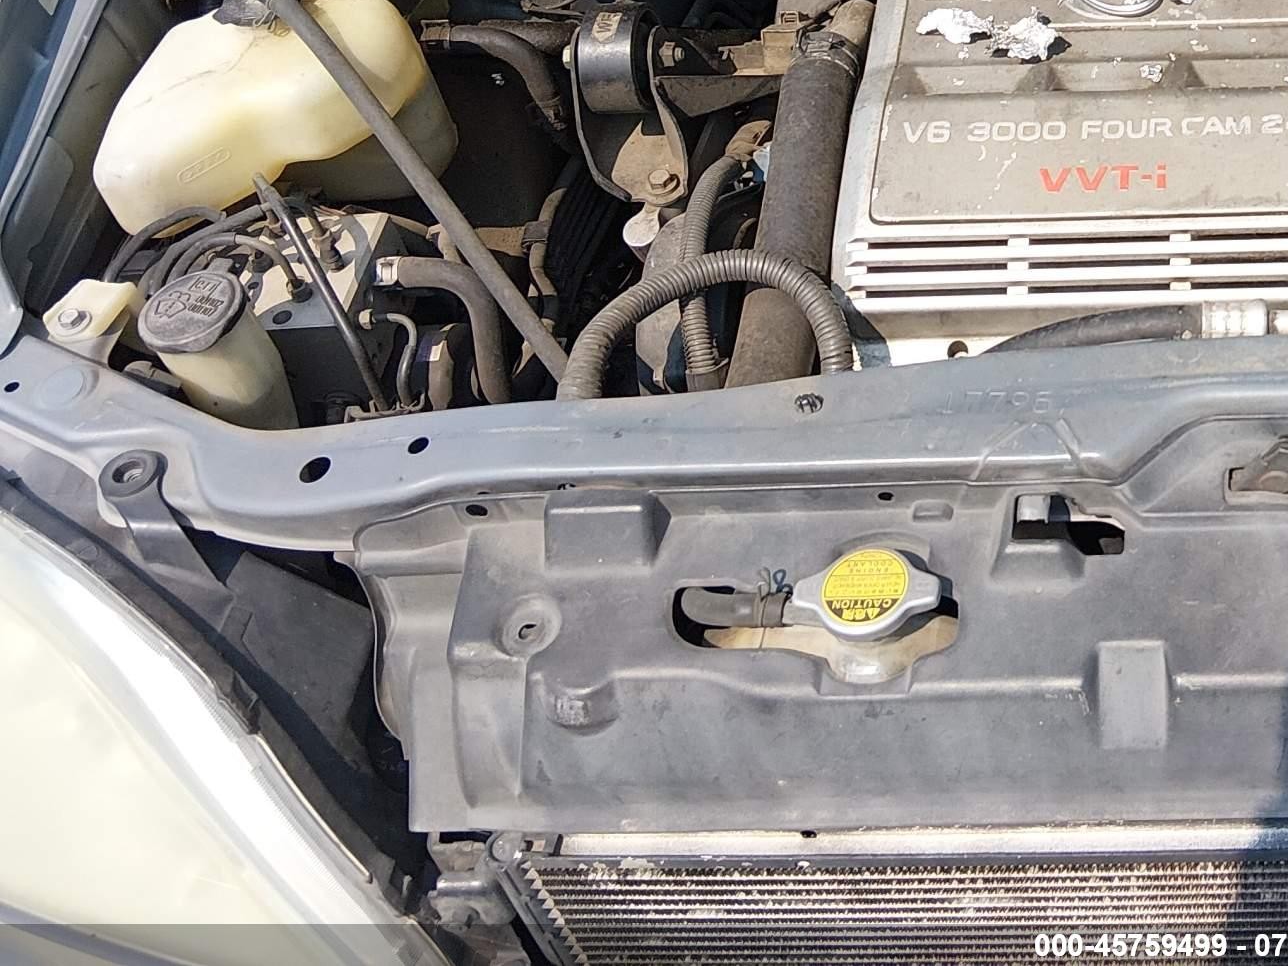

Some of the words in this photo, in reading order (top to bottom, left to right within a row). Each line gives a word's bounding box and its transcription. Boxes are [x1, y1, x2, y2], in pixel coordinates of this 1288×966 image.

[903, 121, 951, 143] V6
[967, 120, 1067, 142] 3000
[1081, 117, 1172, 140] FOUR
[1181, 115, 1252, 137] CAM
[1039, 163, 1168, 193] VVT-i
[832, 599, 892, 610] CAUTION
